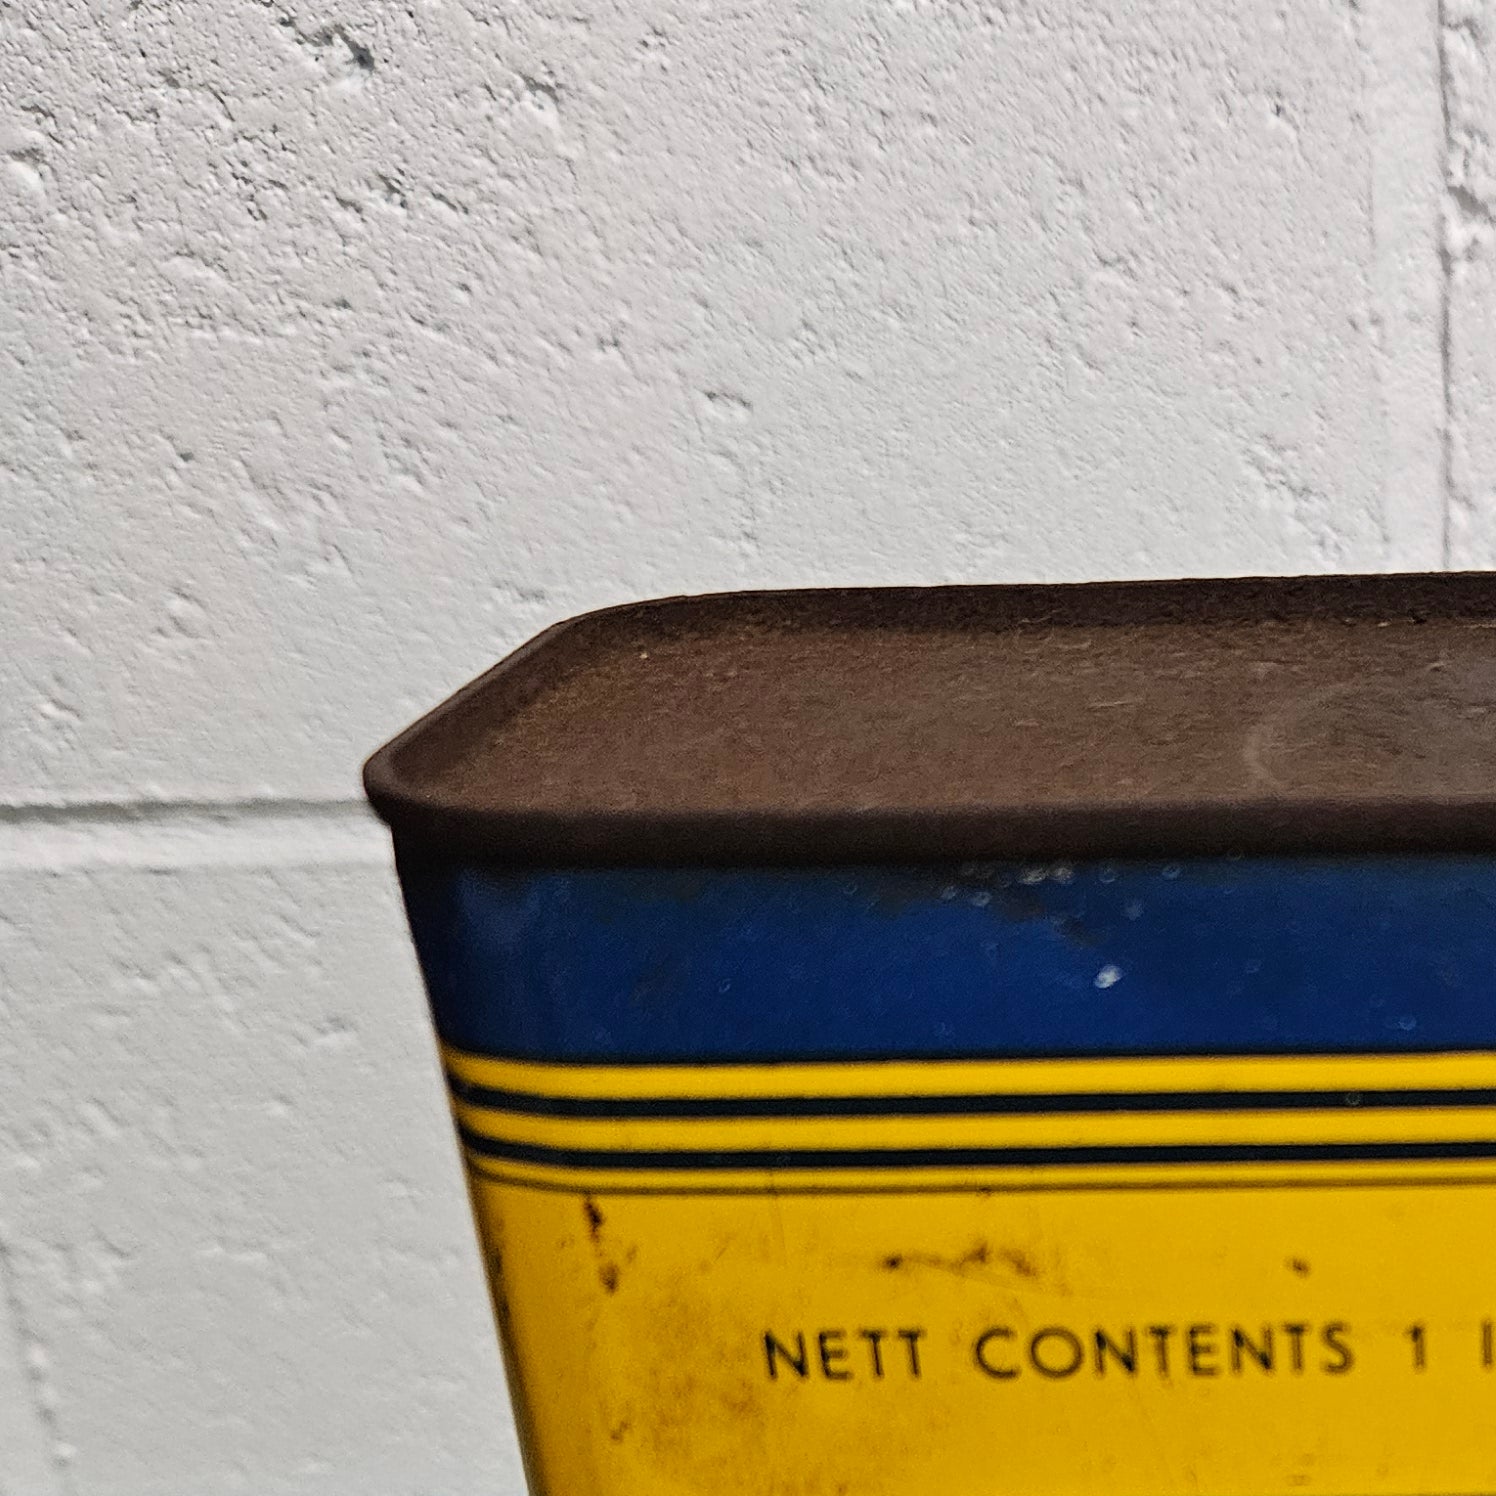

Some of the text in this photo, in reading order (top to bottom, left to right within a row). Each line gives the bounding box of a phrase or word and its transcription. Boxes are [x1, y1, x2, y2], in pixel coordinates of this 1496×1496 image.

[763, 1326, 924, 1381] NETT
[974, 1321, 1356, 1379] CONTENTS
[1408, 1322, 1426, 1370] 1
